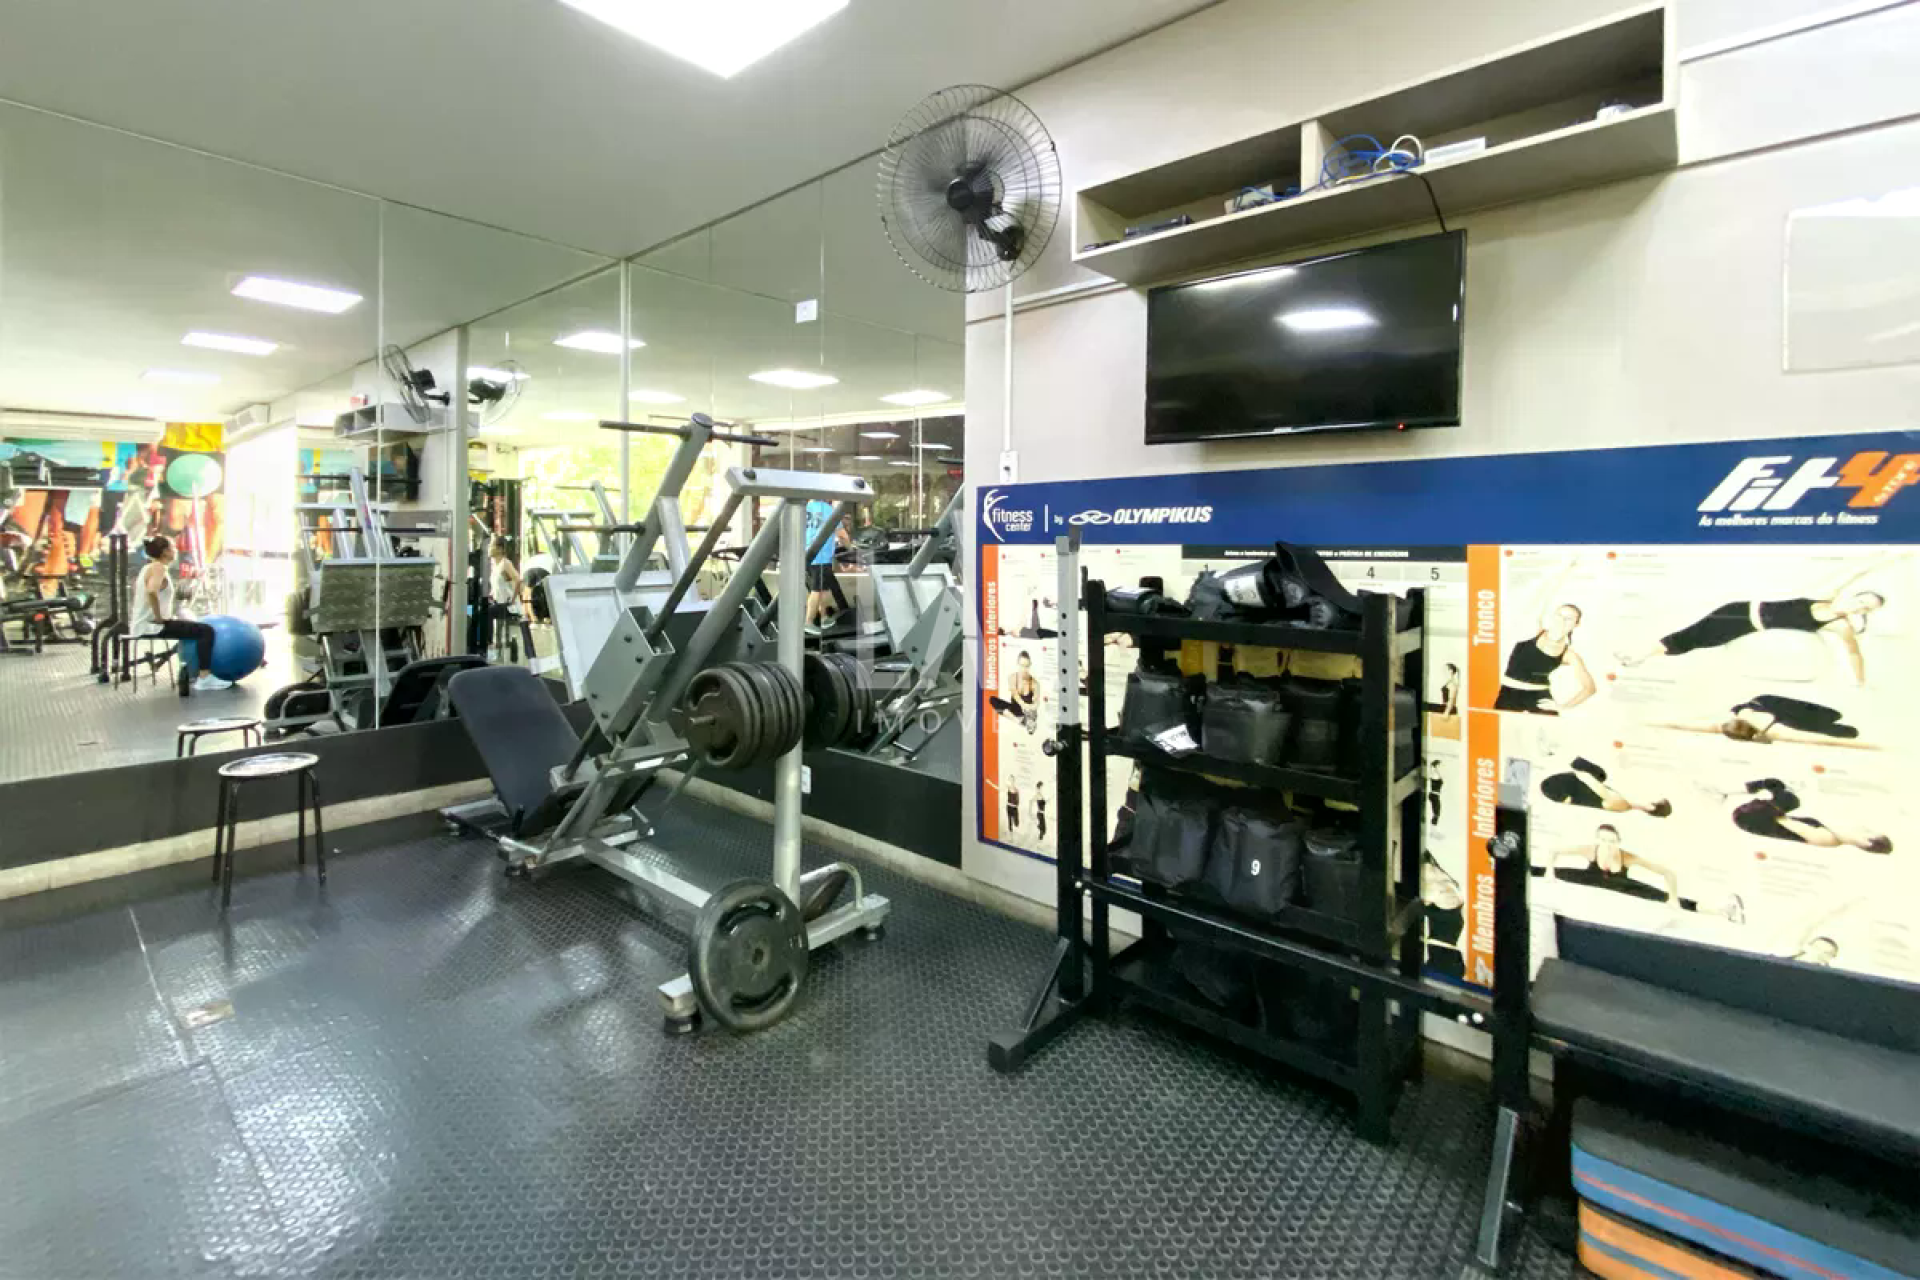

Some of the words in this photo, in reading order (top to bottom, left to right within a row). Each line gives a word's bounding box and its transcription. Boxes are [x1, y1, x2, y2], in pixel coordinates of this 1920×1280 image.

[991, 507, 1034, 523] fitness
[1053, 515, 1064, 526] by
[1113, 506, 1212, 525] OLYMPIKUS
[1698, 514, 1713, 527] As
[1714, 513, 1768, 527] melhores
[1770, 514, 1814, 526] marcas
[1816, 512, 1834, 526] do
[1836, 512, 1879, 526] fitness
[1004, 521, 1033, 532] center
[1366, 566, 1376, 580] 4
[1430, 567, 1440, 582] 5
[985, 581, 998, 635] Inferiores
[1472, 589, 1495, 647] Tronco
[985, 638, 998, 690] Membros
[1472, 757, 1496, 838] Inferiores
[1250, 859, 1261, 876] 9
[1472, 873, 1495, 954] Membros
